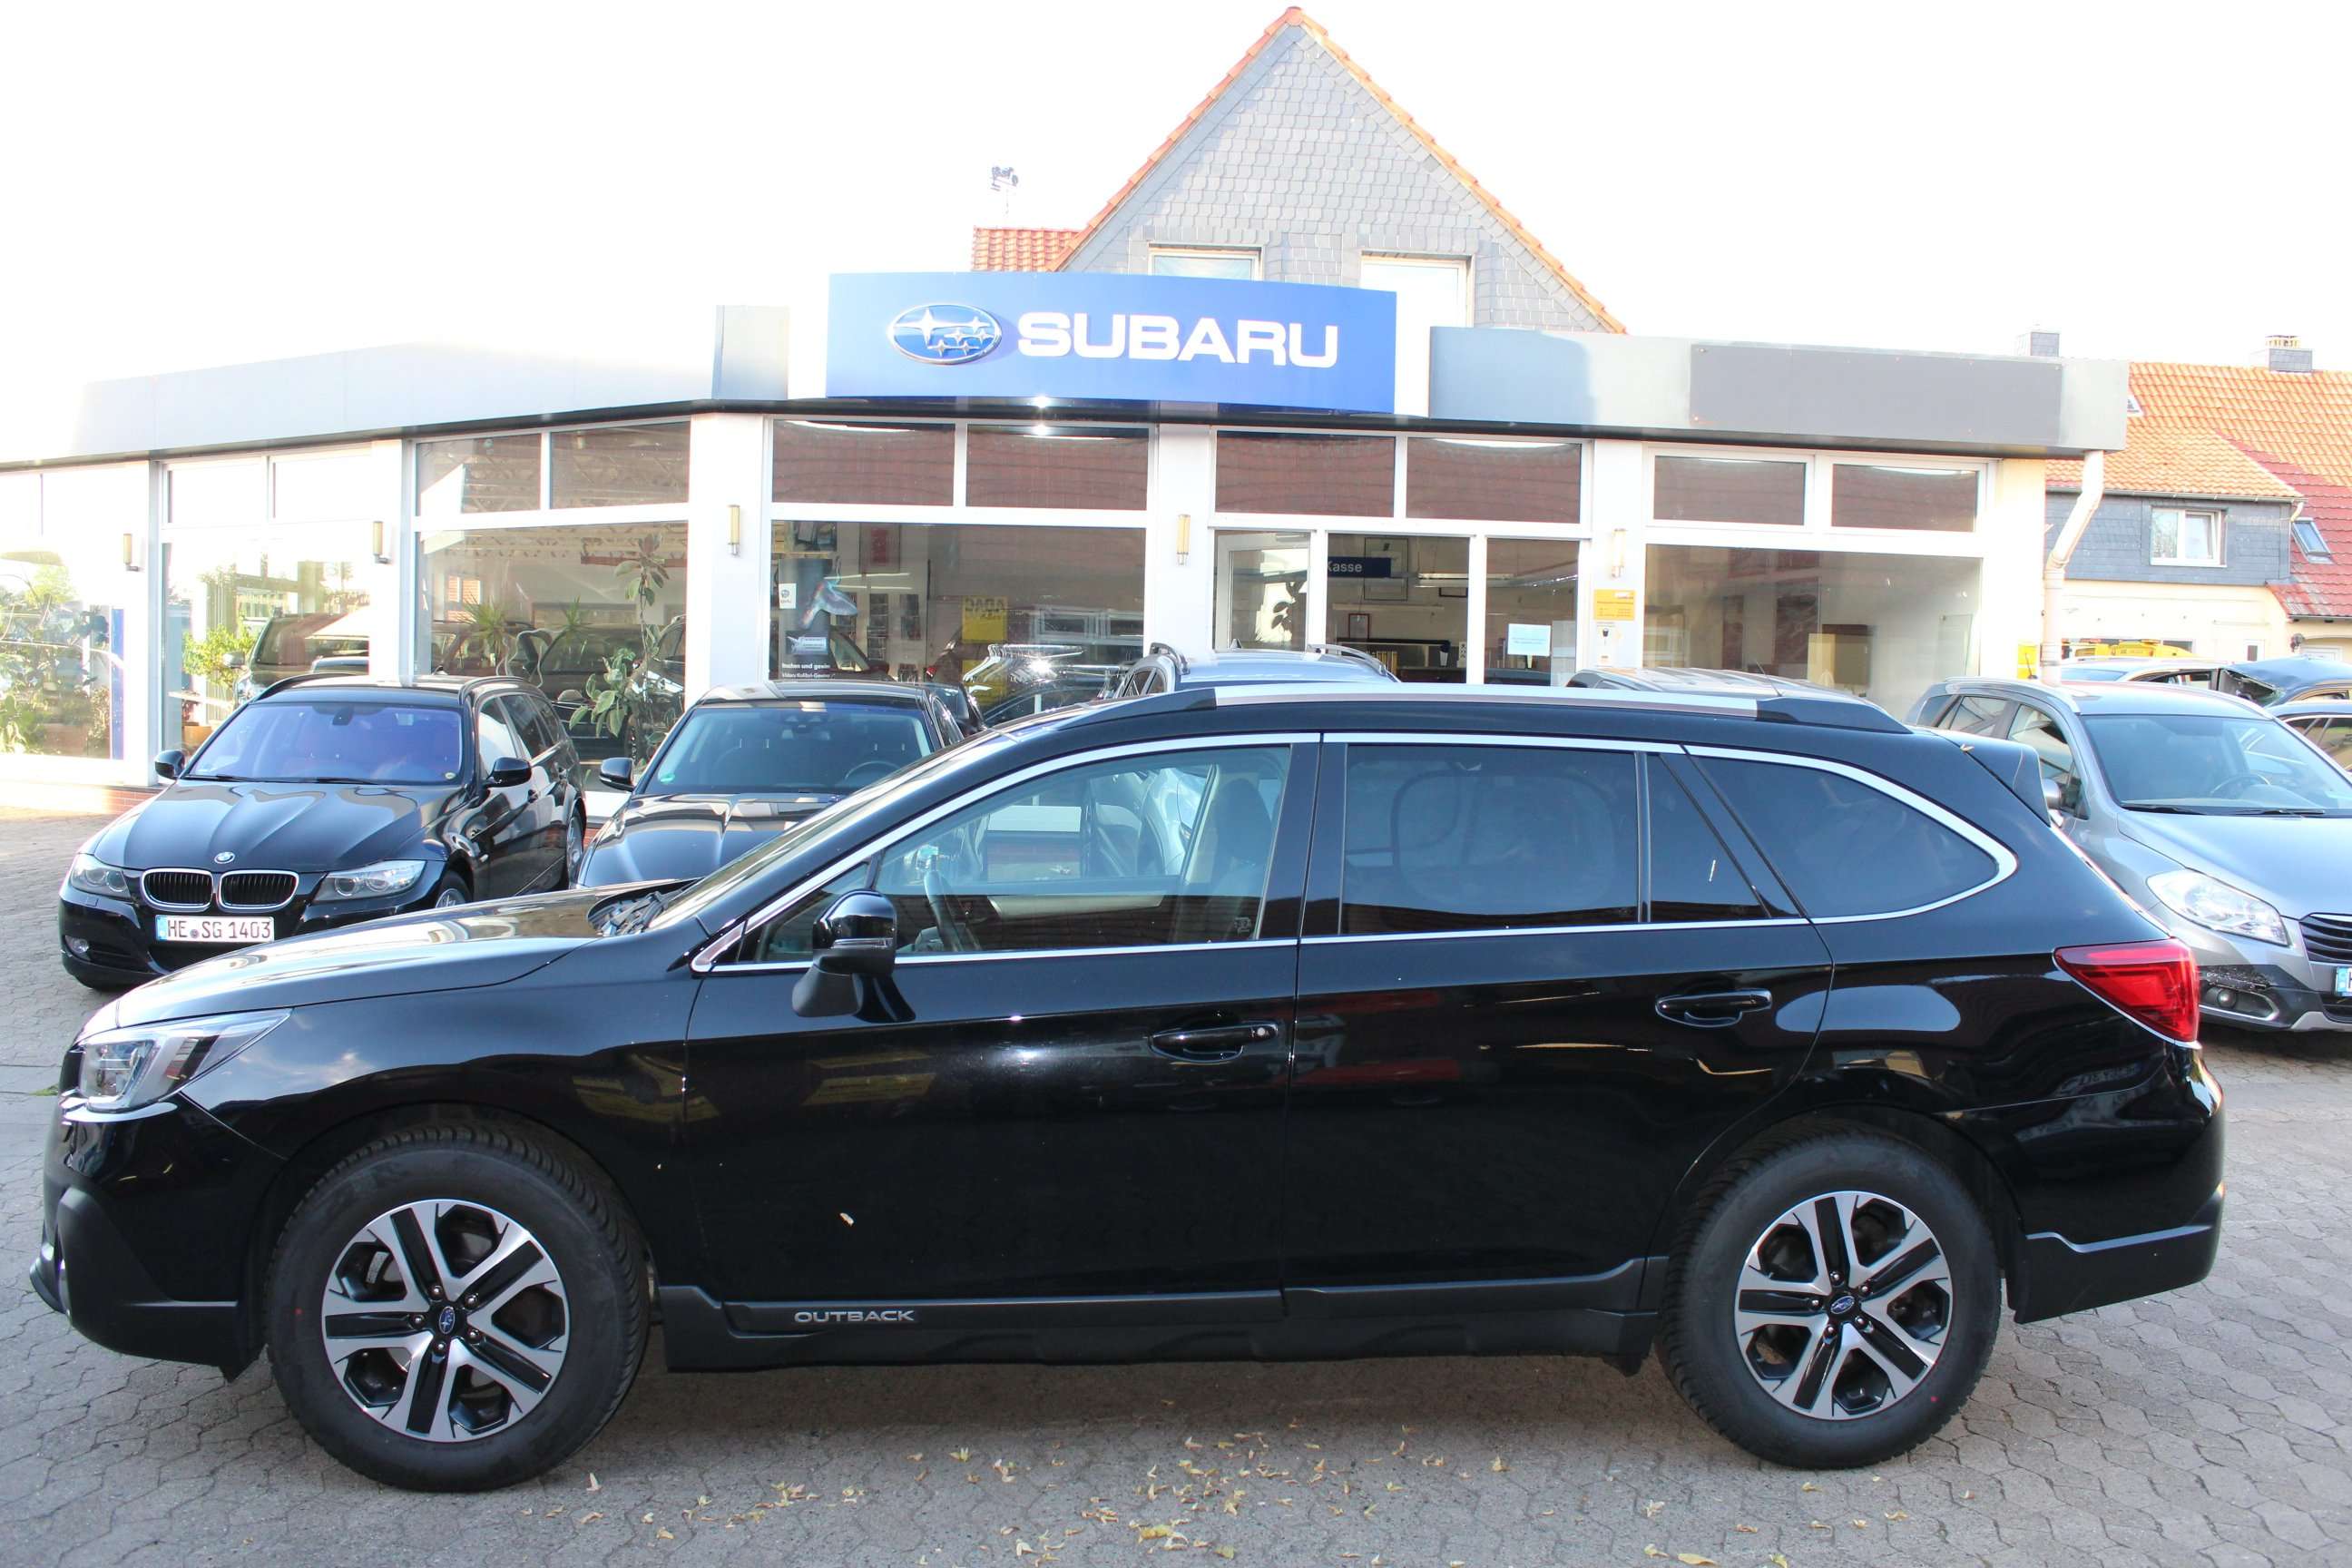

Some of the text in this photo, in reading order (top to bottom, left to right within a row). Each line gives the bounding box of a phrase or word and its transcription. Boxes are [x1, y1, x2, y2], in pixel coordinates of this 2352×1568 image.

[1017, 311, 1338, 368] SUBARU
[167, 920, 270, 939] HE SG 1403
[794, 1310, 915, 1323] OUTBACK
